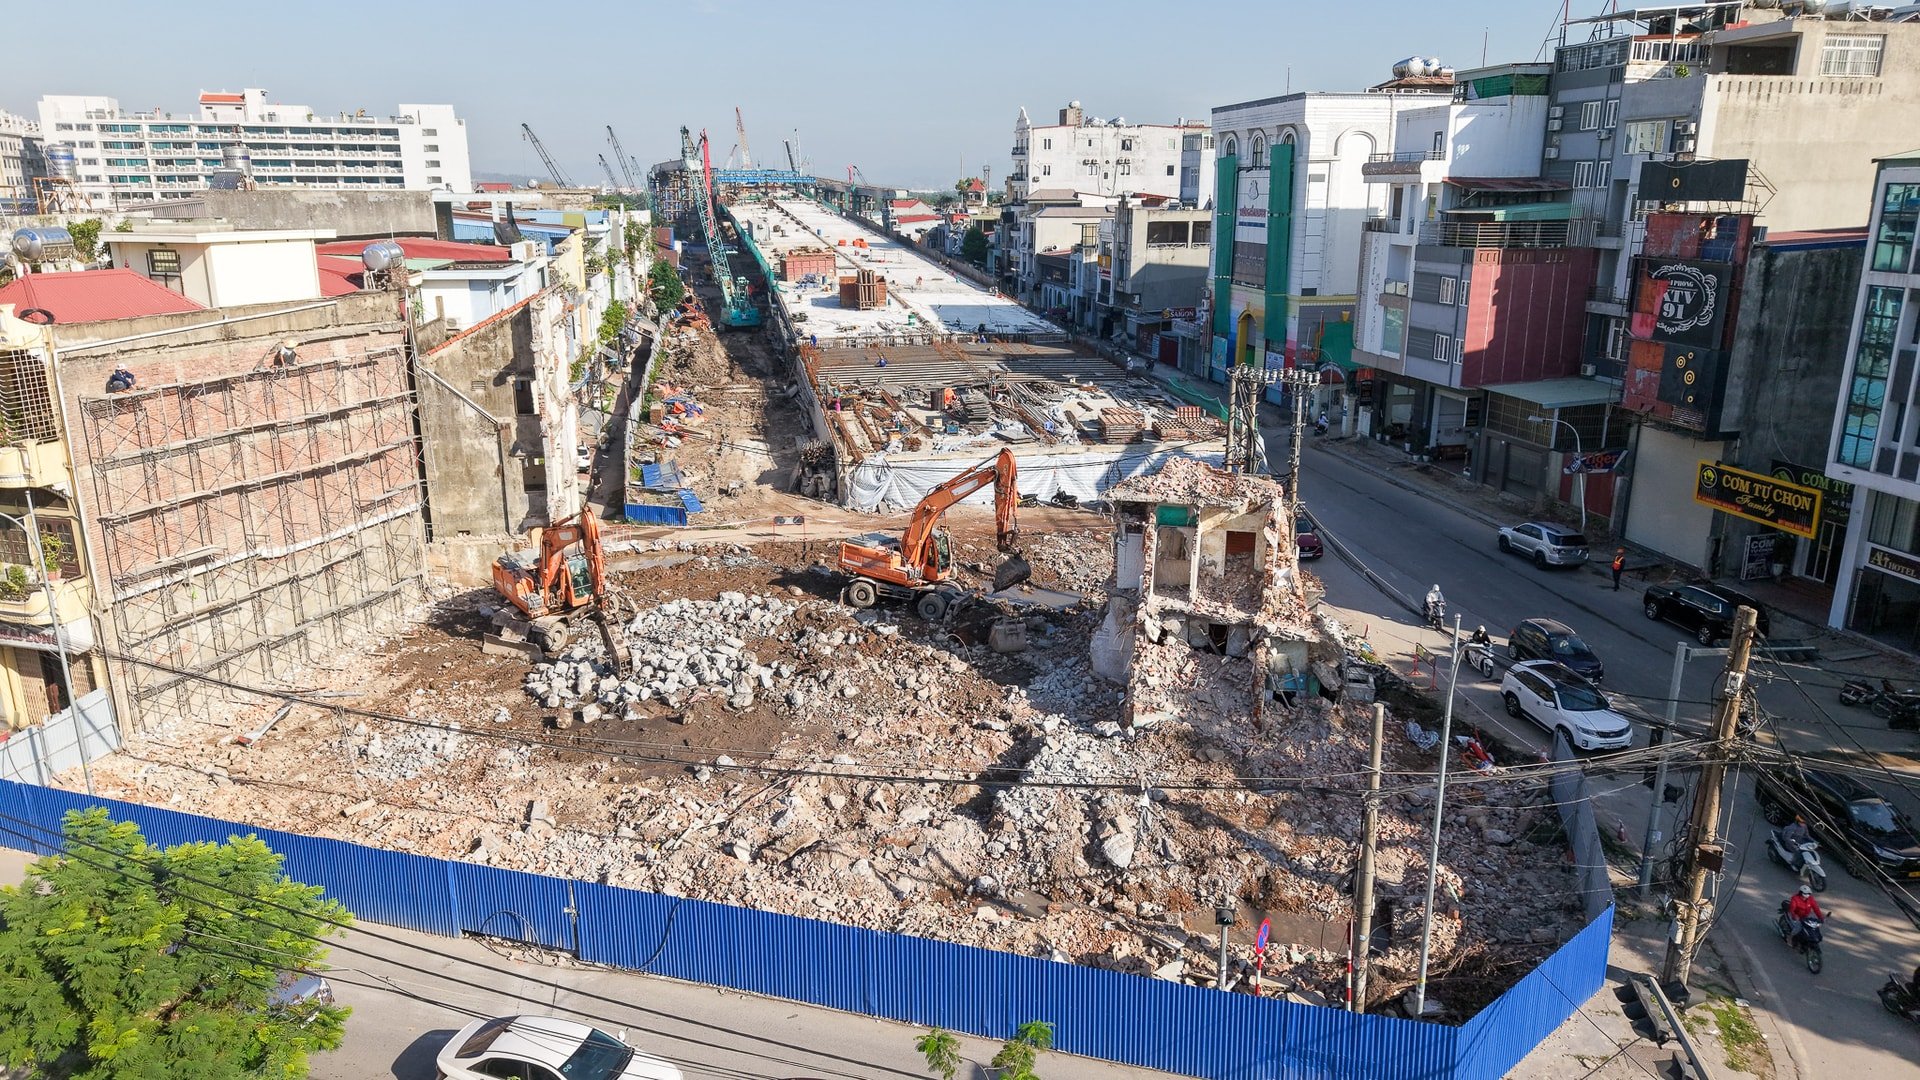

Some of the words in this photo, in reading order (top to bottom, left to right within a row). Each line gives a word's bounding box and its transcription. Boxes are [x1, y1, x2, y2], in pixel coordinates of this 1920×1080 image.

[1662, 302, 1685, 319] 91
[1802, 472, 1830, 490] CƠM
[1722, 475, 1751, 494] CƠM
[1753, 483, 1773, 502] TỰ
[1772, 489, 1812, 511] CHỌN
[1735, 494, 1775, 517] Family
[1889, 562, 1917, 577] HOTEL
